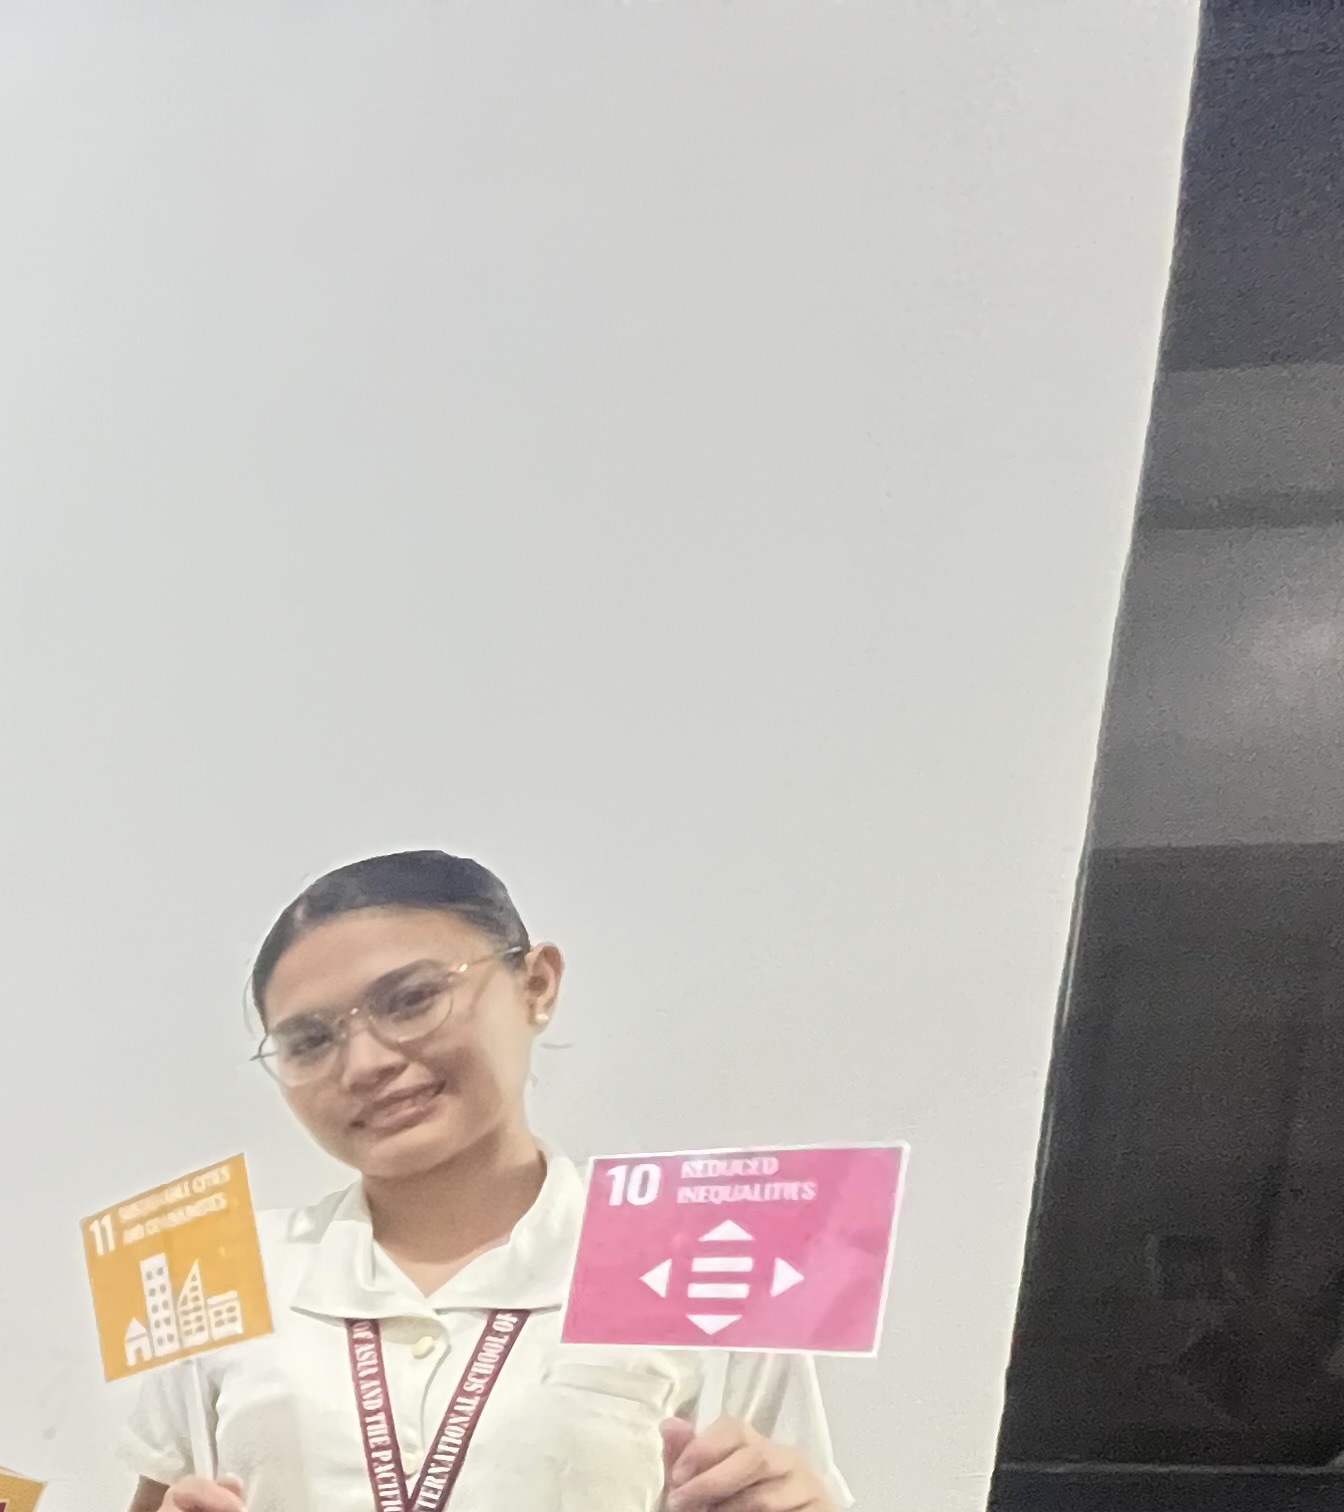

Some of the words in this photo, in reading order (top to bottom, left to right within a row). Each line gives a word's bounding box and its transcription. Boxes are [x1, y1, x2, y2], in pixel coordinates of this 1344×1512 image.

[606, 1163, 661, 1206] 10
[680, 1157, 780, 1179] REDUCED
[676, 1181, 818, 1205] INEQUALITIES
[89, 1213, 116, 1256] 11
[354, 1343, 378, 1378] ASIA
[463, 1335, 509, 1394] SCHOOL
[360, 1379, 383, 1411] AND
[365, 1412, 391, 1448] THE
